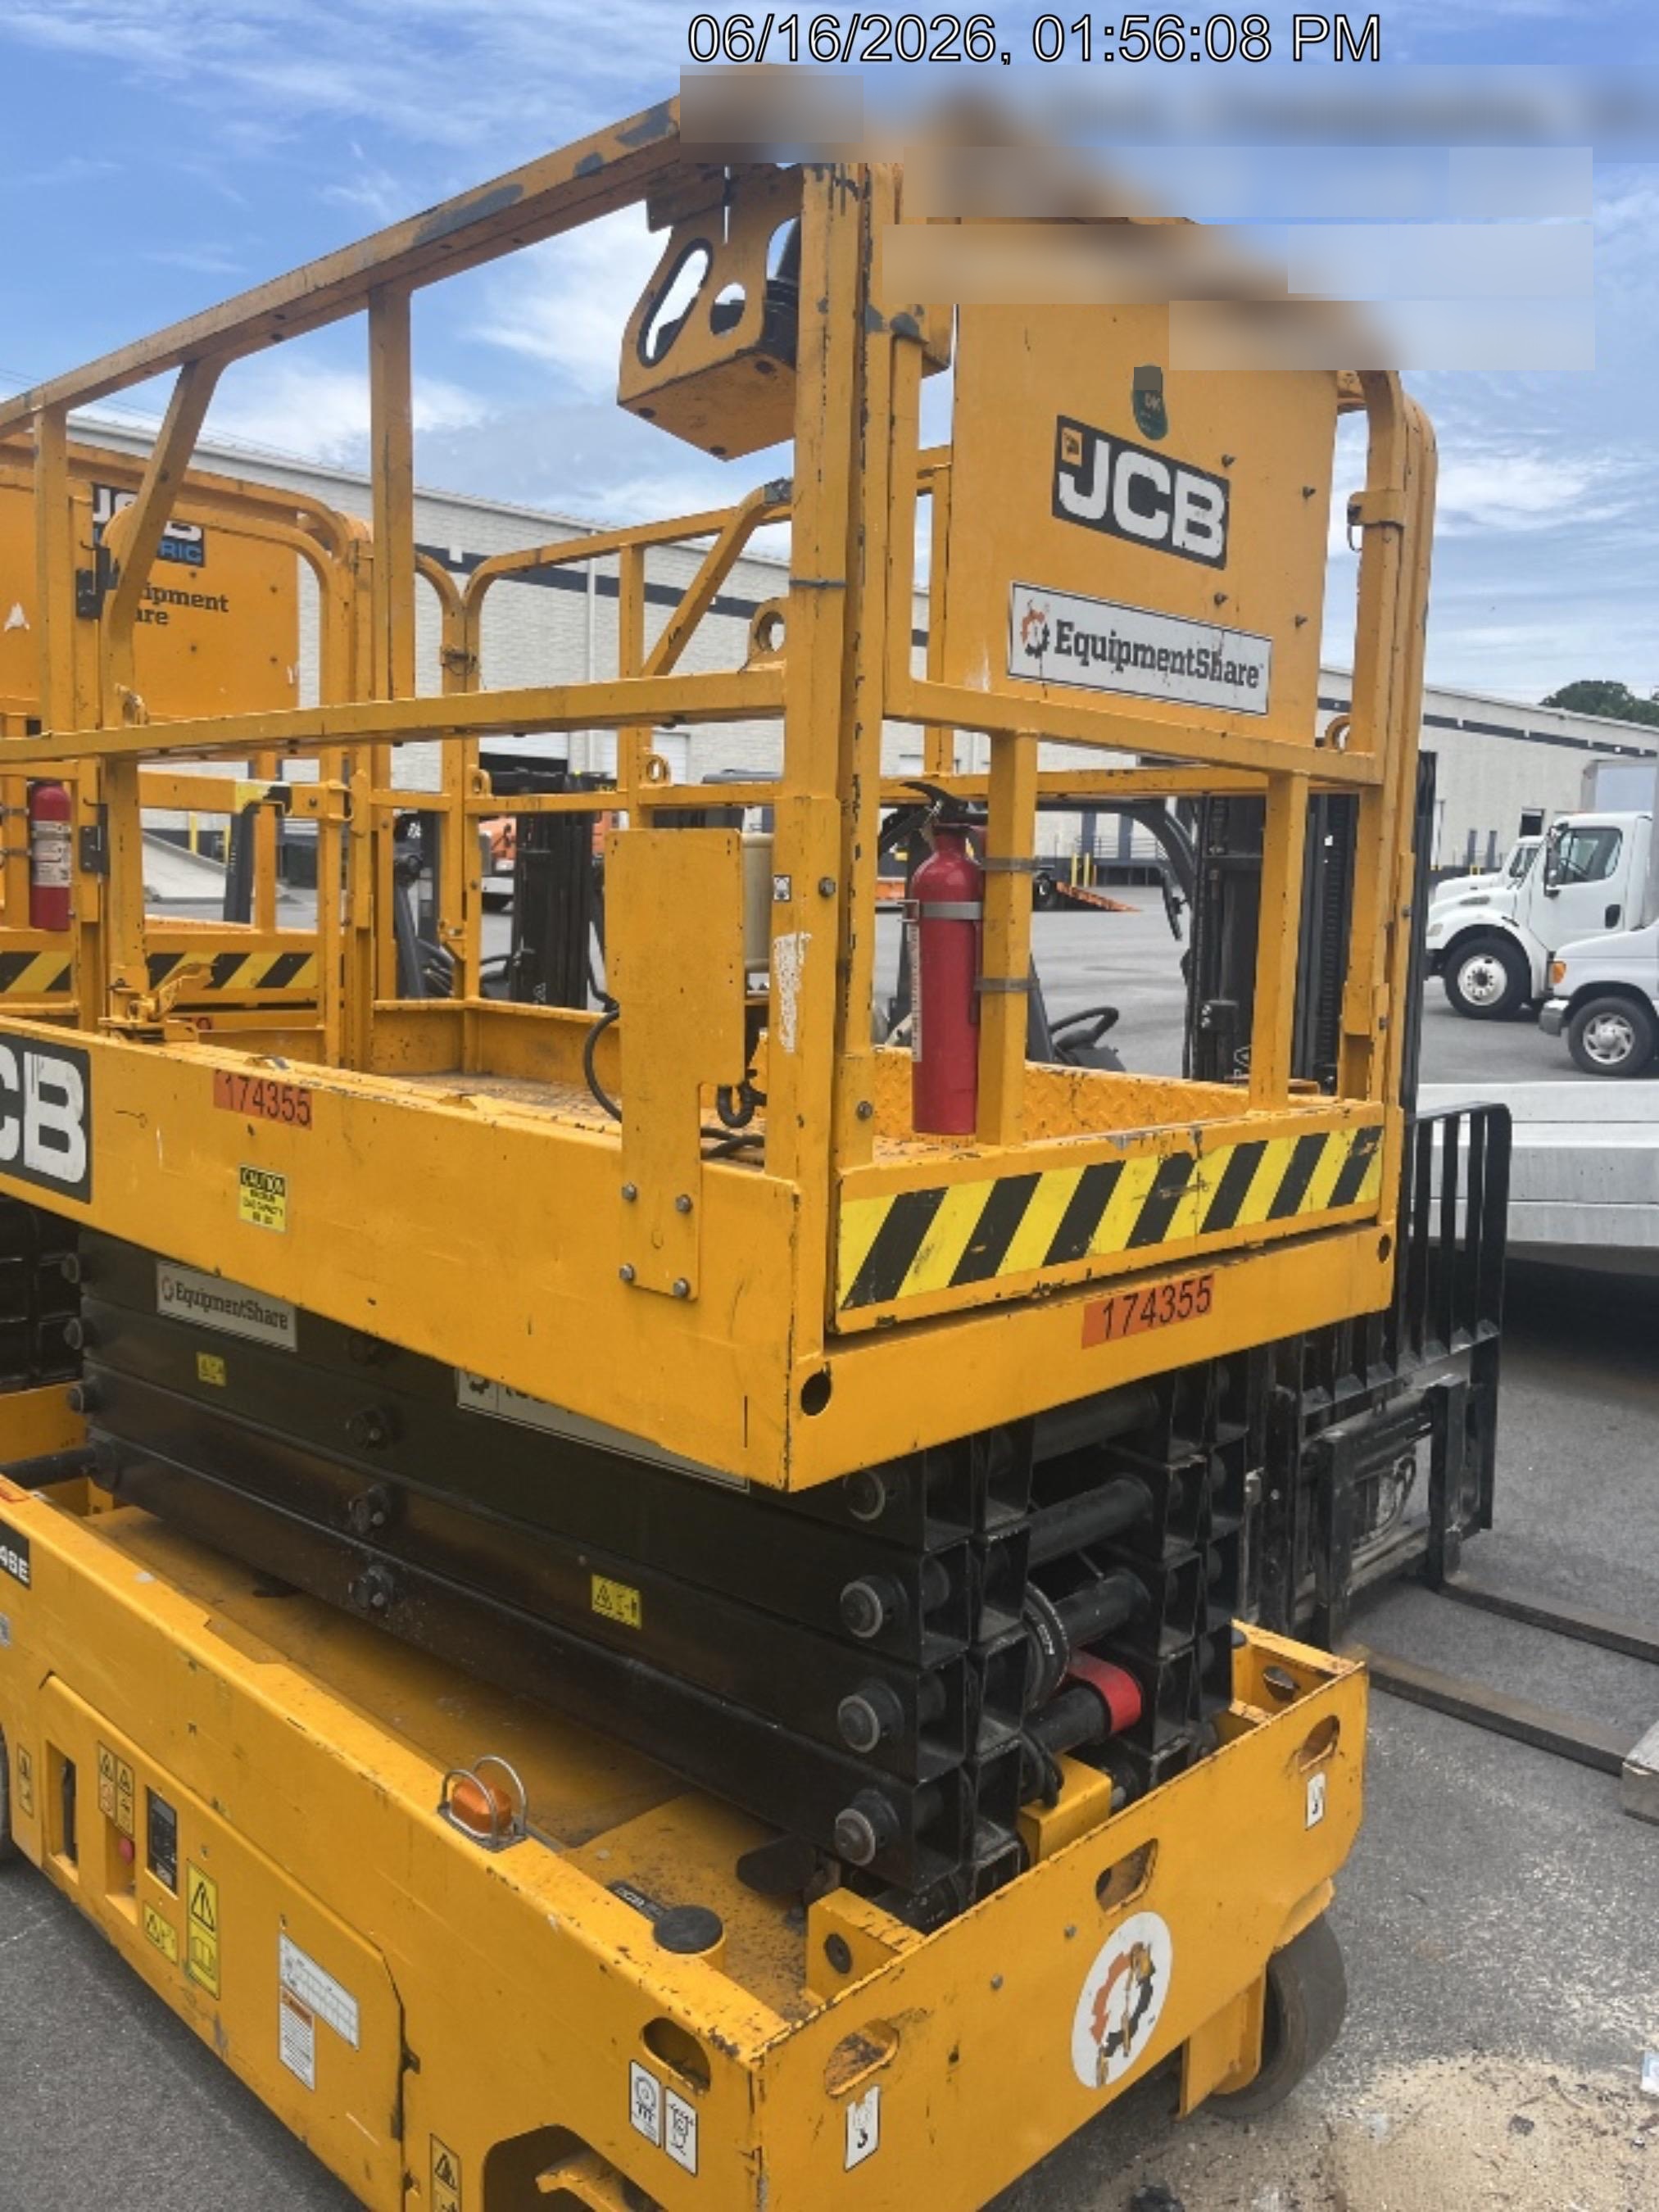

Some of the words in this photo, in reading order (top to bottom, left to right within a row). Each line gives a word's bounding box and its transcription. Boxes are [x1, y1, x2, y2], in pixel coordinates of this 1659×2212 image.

[1058, 438, 1226, 558] JCB
[1054, 619, 1260, 688] EquipmentShare
[225, 1074, 310, 1126] 174355
[175, 1281, 289, 1330] EquipmentShare
[1103, 1274, 1213, 1339] 174355
